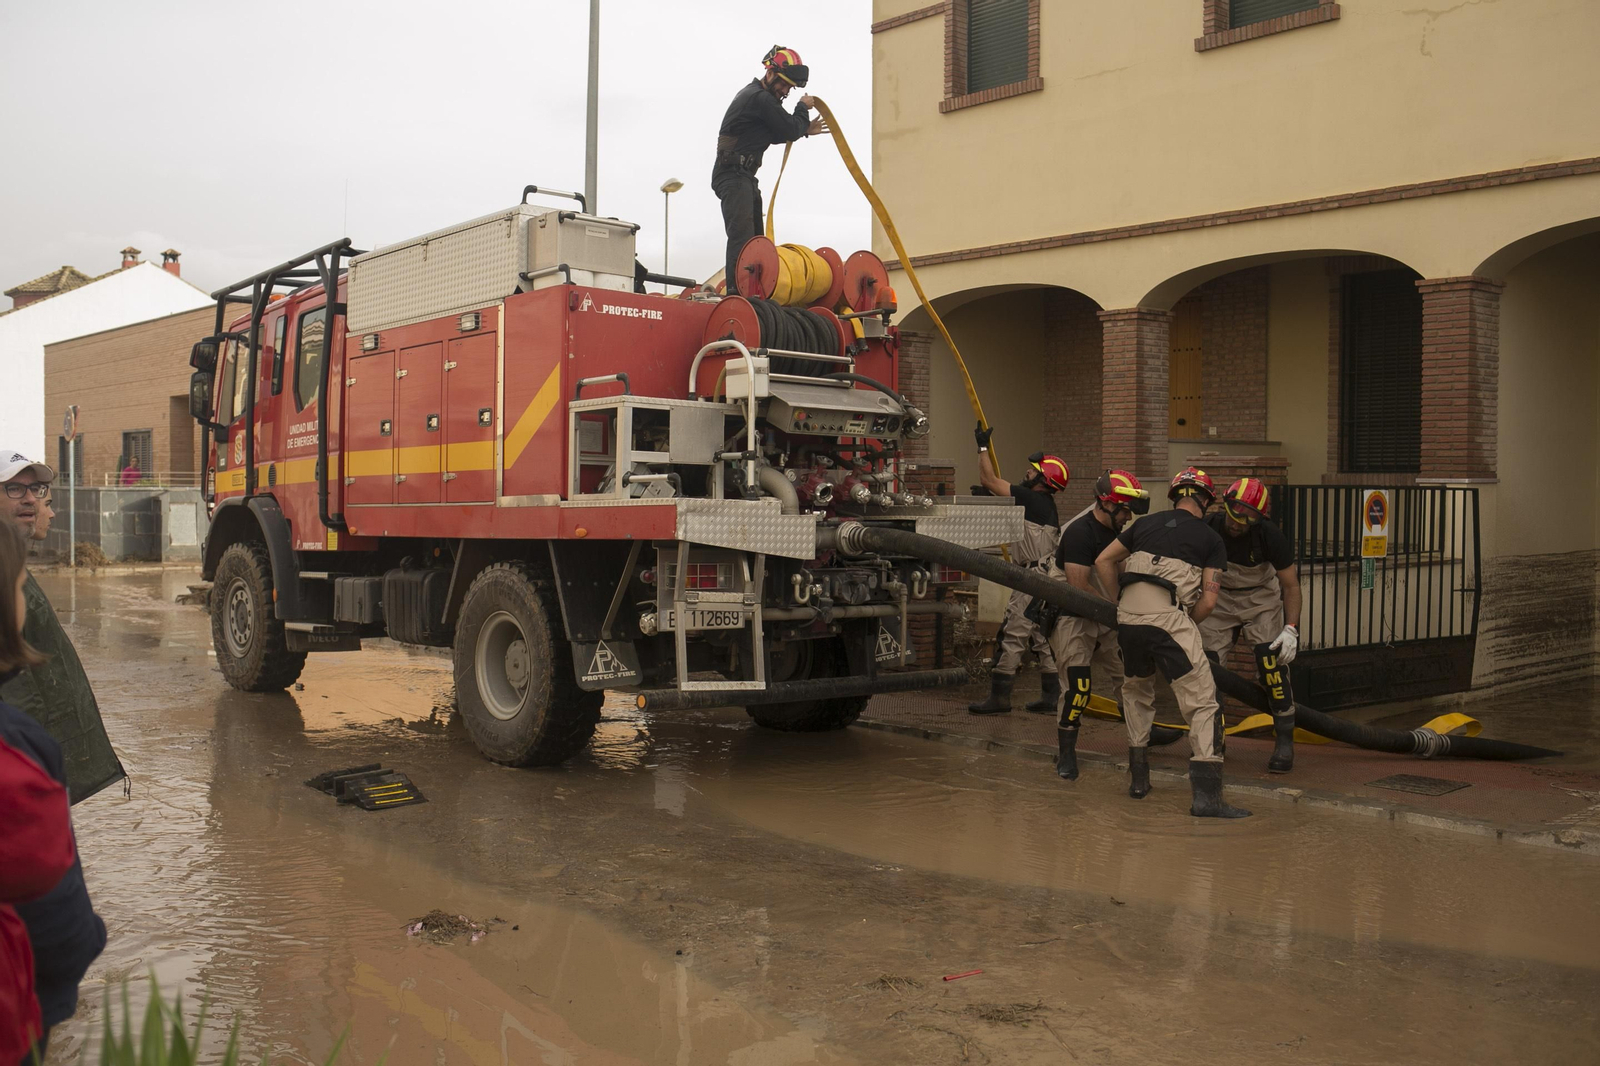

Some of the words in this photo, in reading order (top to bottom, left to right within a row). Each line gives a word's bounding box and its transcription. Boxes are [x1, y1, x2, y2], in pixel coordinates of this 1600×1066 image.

[602, 304, 663, 320] PROTEC-FIRE
[289, 422, 306, 435] UNIDAD
[287, 438, 293, 449] DE
[691, 610, 740, 627] 112669
[308, 634, 339, 643] IVECO
[581, 671, 637, 682] PROTEC-FIRE
[1262, 655, 1285, 699] UME
[1068, 678, 1090, 721] UME
